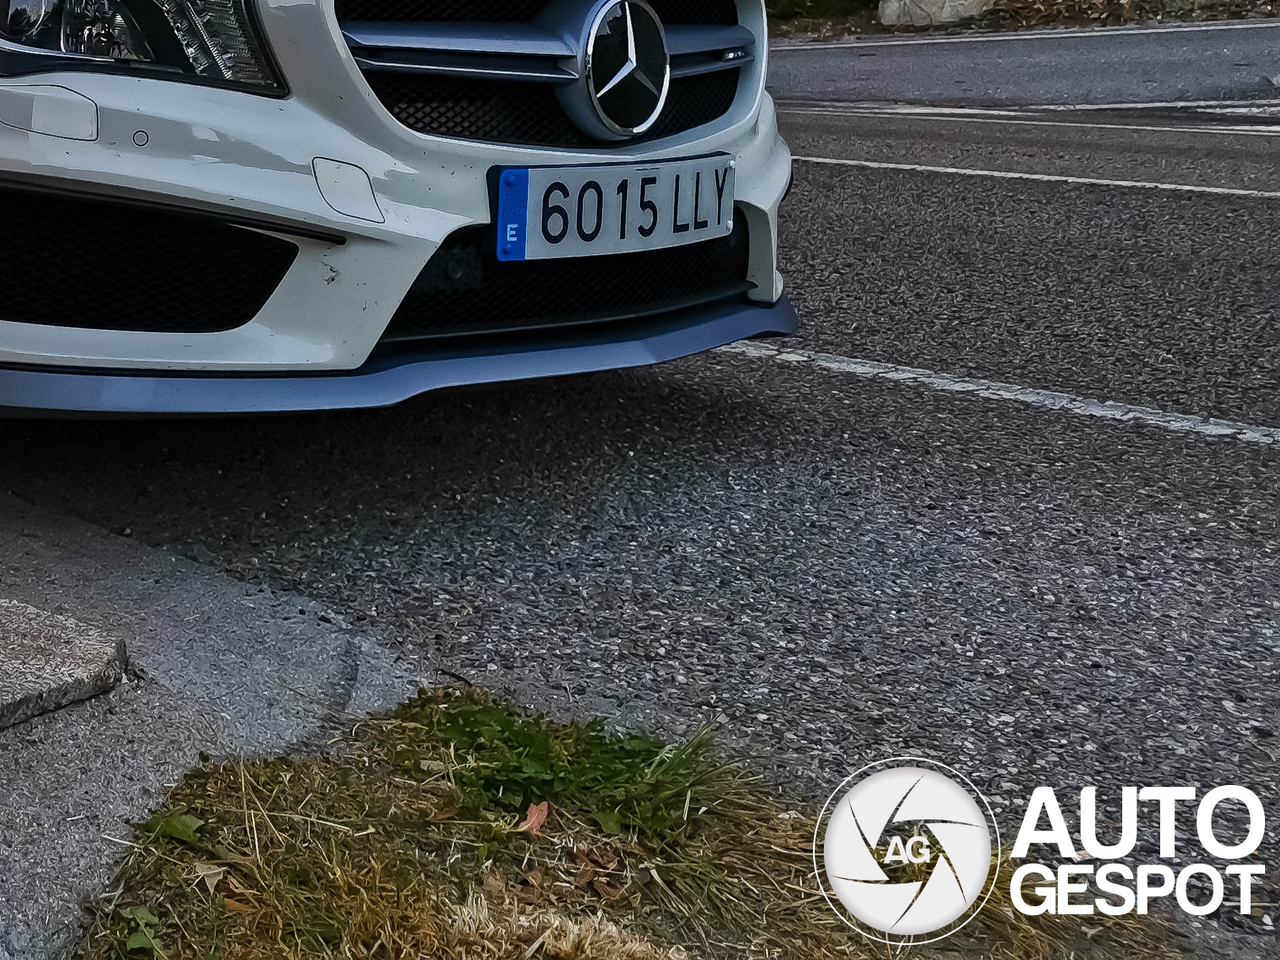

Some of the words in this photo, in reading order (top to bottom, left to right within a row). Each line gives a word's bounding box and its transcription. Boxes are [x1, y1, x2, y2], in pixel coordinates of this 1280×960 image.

[541, 176, 658, 244] 6015
[672, 167, 728, 234] LLY
[506, 223, 518, 241] E
